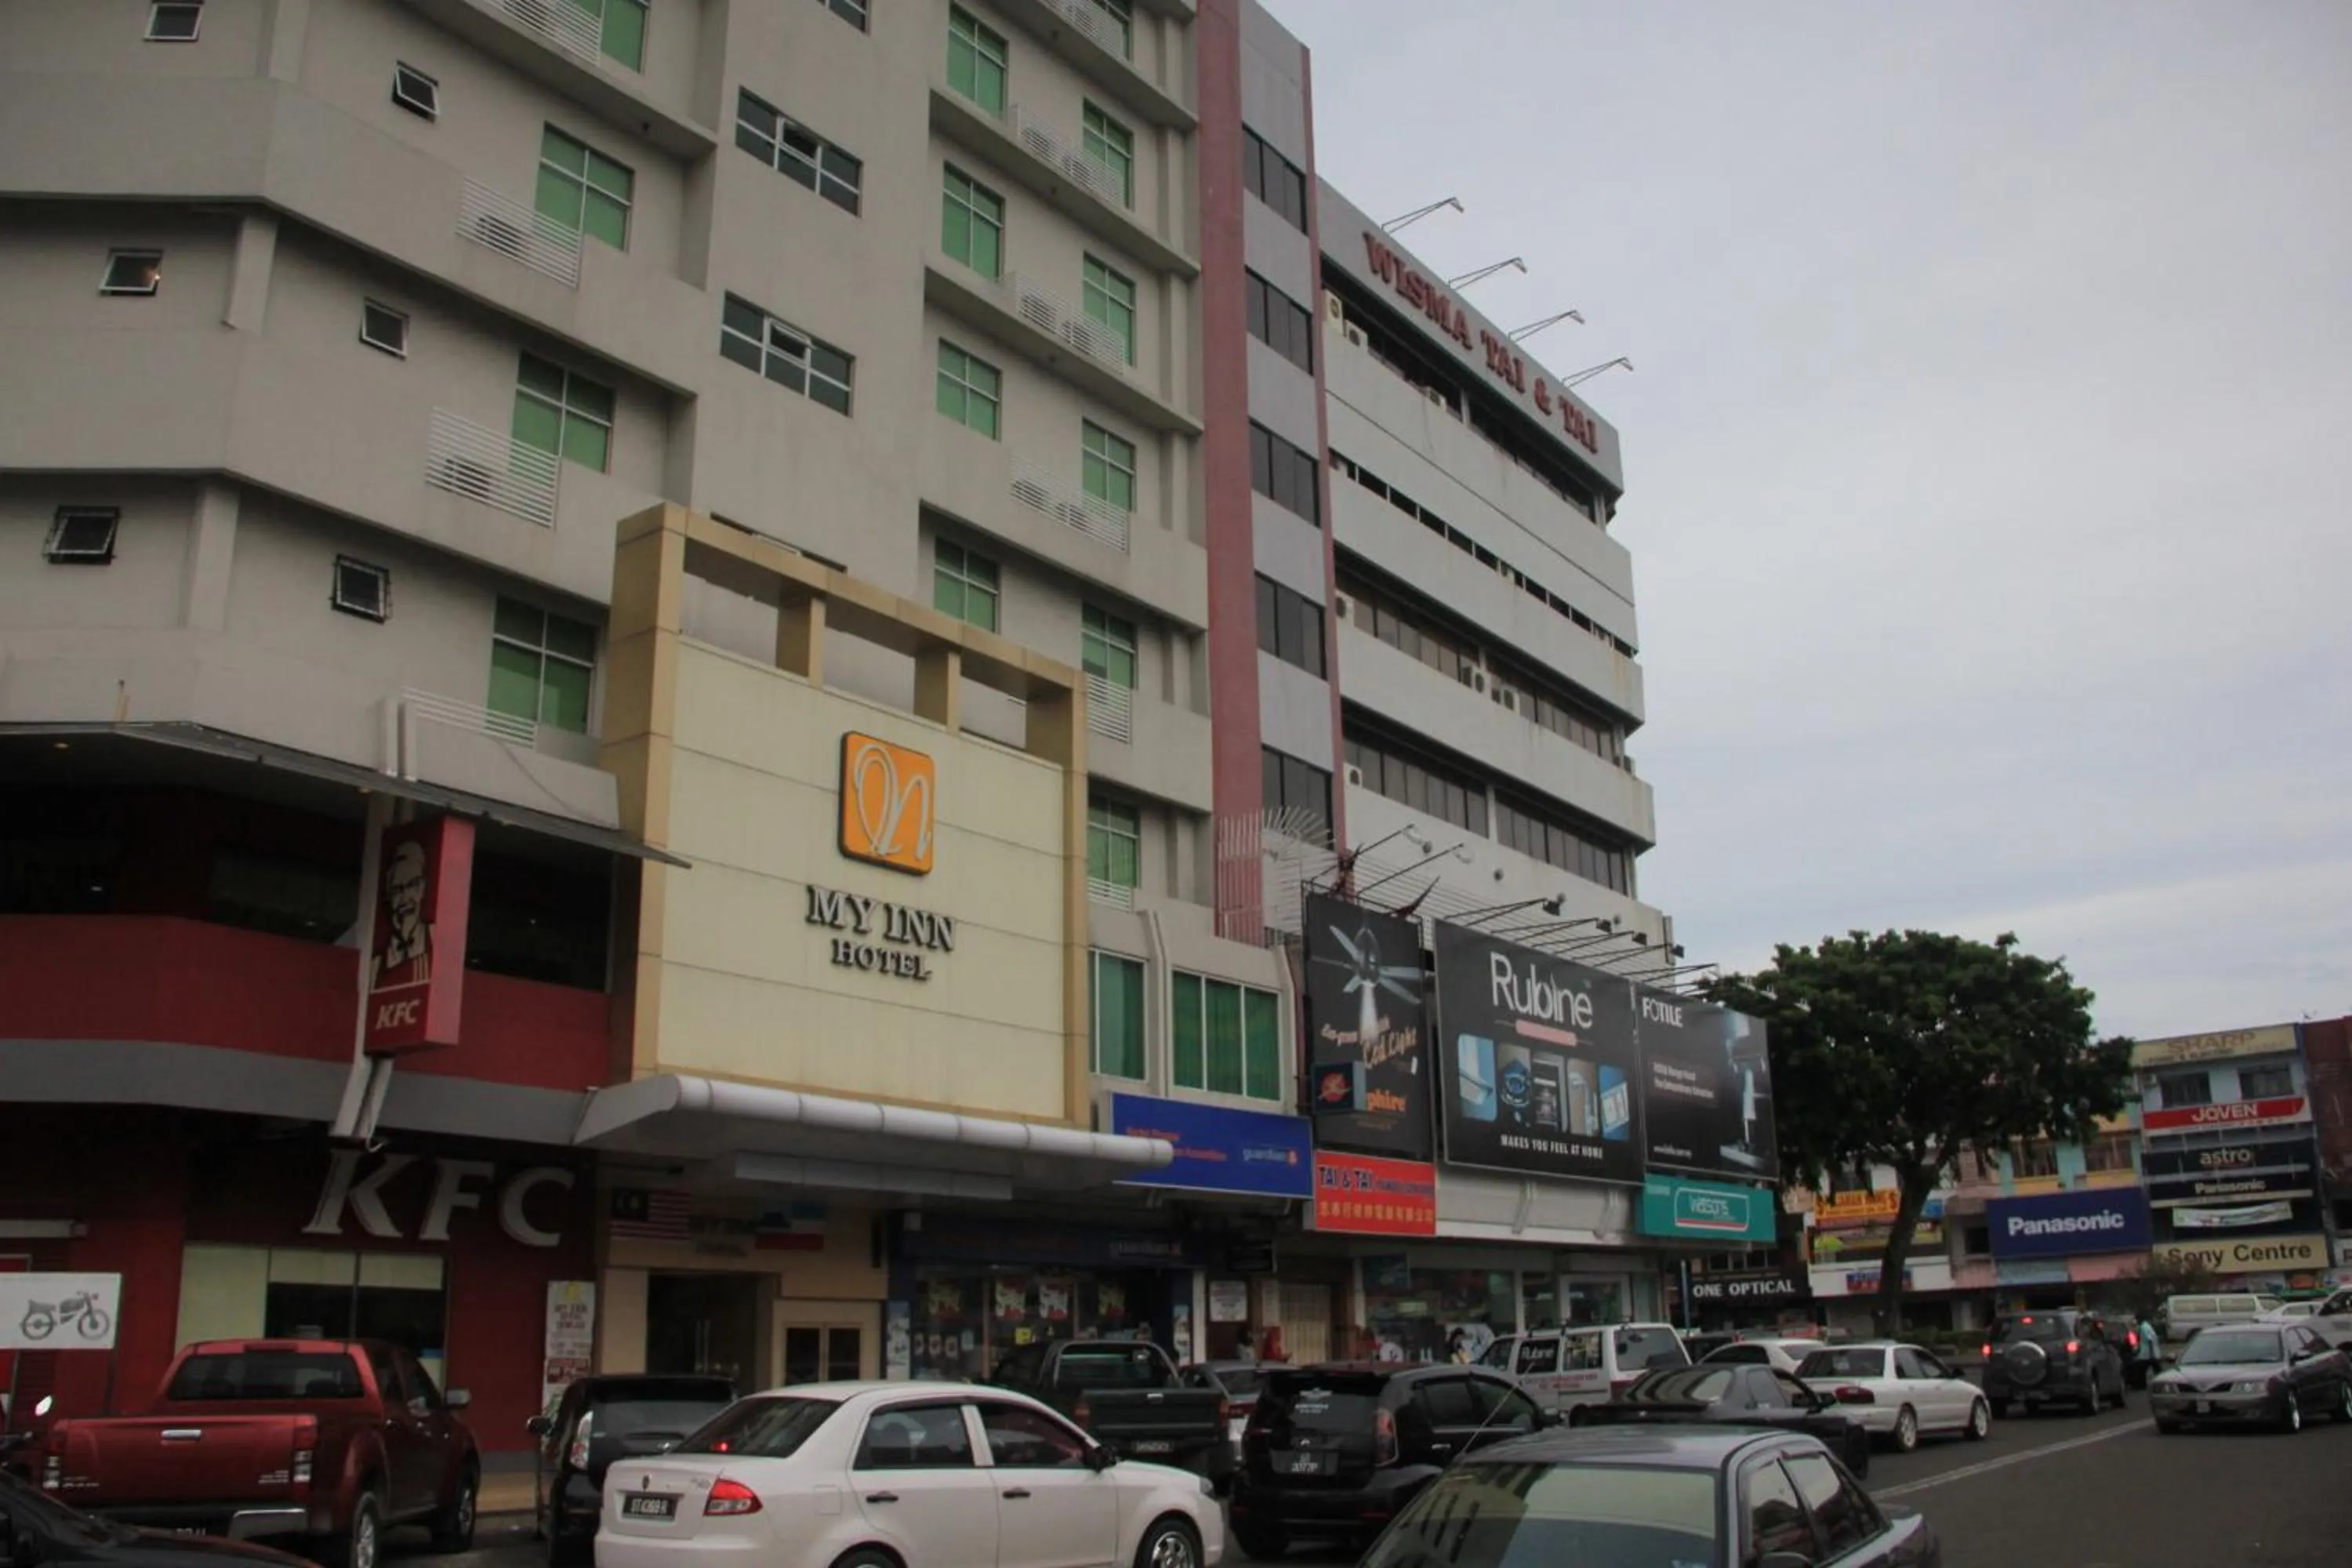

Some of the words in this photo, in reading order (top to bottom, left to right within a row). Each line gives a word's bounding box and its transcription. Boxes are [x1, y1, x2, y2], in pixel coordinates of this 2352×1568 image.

[1363, 231, 1473, 350] WISMA
[1481, 329, 1526, 394] TAI
[1534, 377, 1552, 417] &
[1558, 395, 1598, 455] TAI
[807, 885, 877, 935] MY
[884, 902, 955, 952] INN
[832, 938, 933, 980] HOTEL
[1490, 951, 1594, 1030] Rubine
[375, 999, 422, 1030] KFC
[1642, 996, 1684, 1029] FOTILE
[2166, 1031, 2256, 1054] SHARP
[1366, 1087, 1406, 1112] phire
[2190, 1103, 2258, 1123] JOVEN
[1500, 1134, 1529, 1150] MAKES
[1531, 1138, 1549, 1153] YOU
[1550, 1141, 1568, 1156] FEEL
[1570, 1143, 1580, 1156] AT
[1581, 1145, 1603, 1160] HOME
[2199, 1147, 2251, 1166] astro
[1317, 1164, 1338, 1188] TAI
[1341, 1167, 1351, 1190] &
[1352, 1167, 1373, 1190] TAI
[2194, 1179, 2266, 1195] Panasonic
[301, 1149, 575, 1247] KFC
[2007, 1210, 2125, 1236] Panasonic
[2168, 1247, 2224, 1269] Sony
[2233, 1242, 2312, 1263] Centre
[1693, 1283, 1723, 1298] ONE
[1728, 1279, 1796, 1296] OPTICAL
